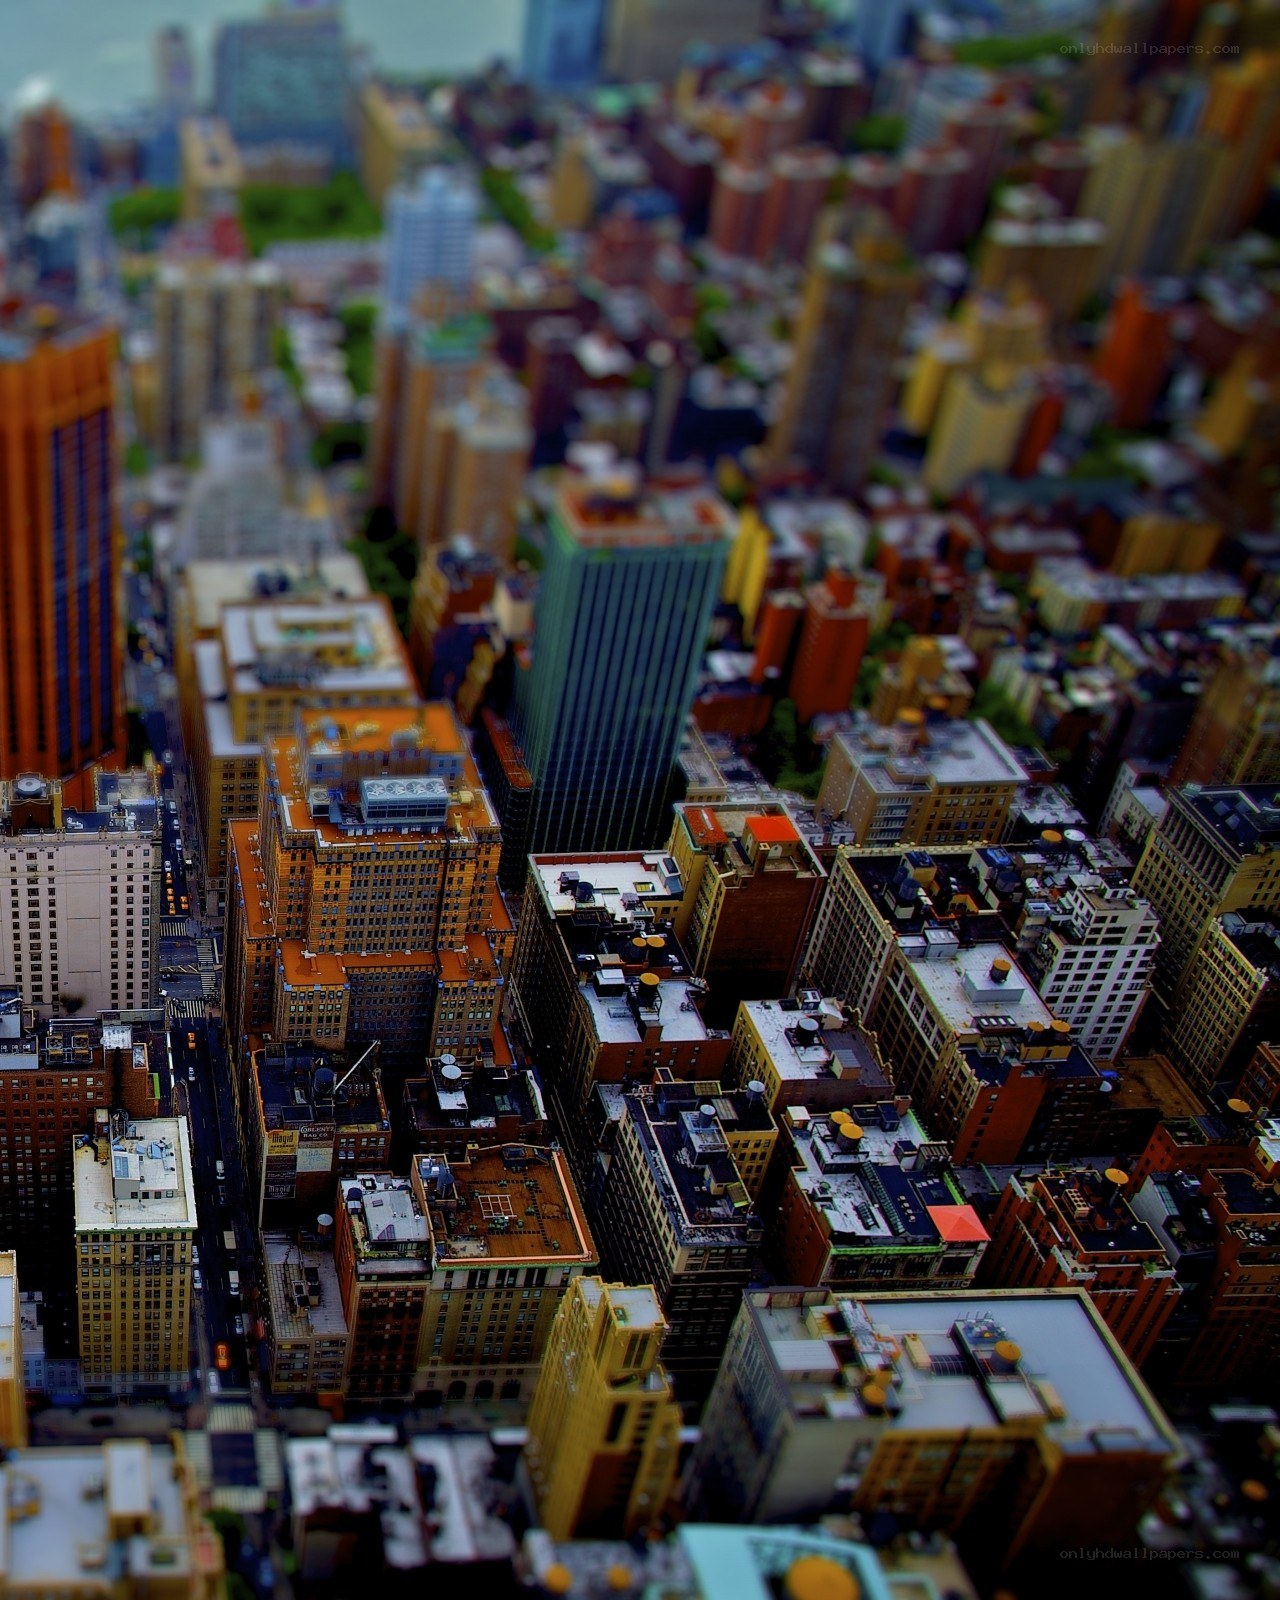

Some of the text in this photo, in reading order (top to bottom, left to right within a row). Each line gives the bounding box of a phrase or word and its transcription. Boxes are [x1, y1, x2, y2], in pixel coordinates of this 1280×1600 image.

[300, 1125, 334, 1134] COBLENTZ
[272, 1132, 294, 1144] Magid
[268, 1185, 291, 1194] Magid
